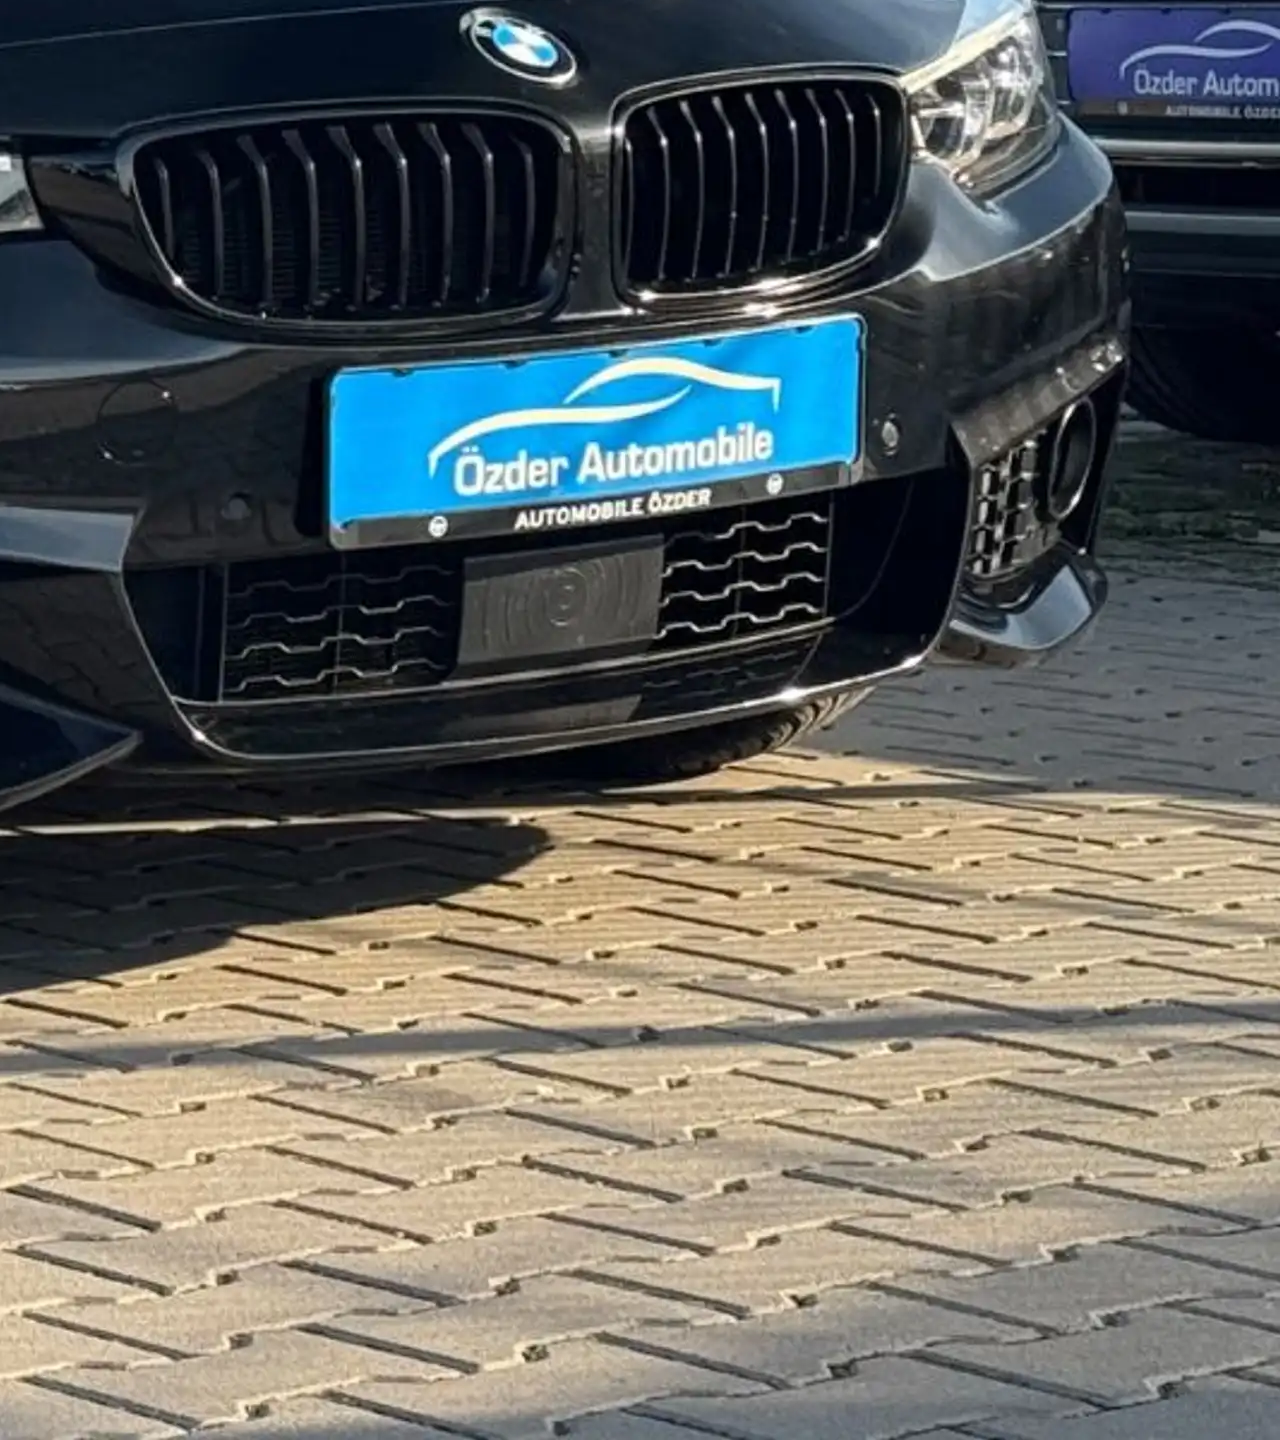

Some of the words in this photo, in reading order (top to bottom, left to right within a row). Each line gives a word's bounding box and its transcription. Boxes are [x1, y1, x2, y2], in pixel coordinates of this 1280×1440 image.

[1133, 62, 1198, 96] Özder
[453, 445, 570, 497] Özder
[577, 421, 775, 486] Automobile
[514, 497, 644, 531] AUTOMOBILE
[647, 487, 712, 514] ÖZDER
